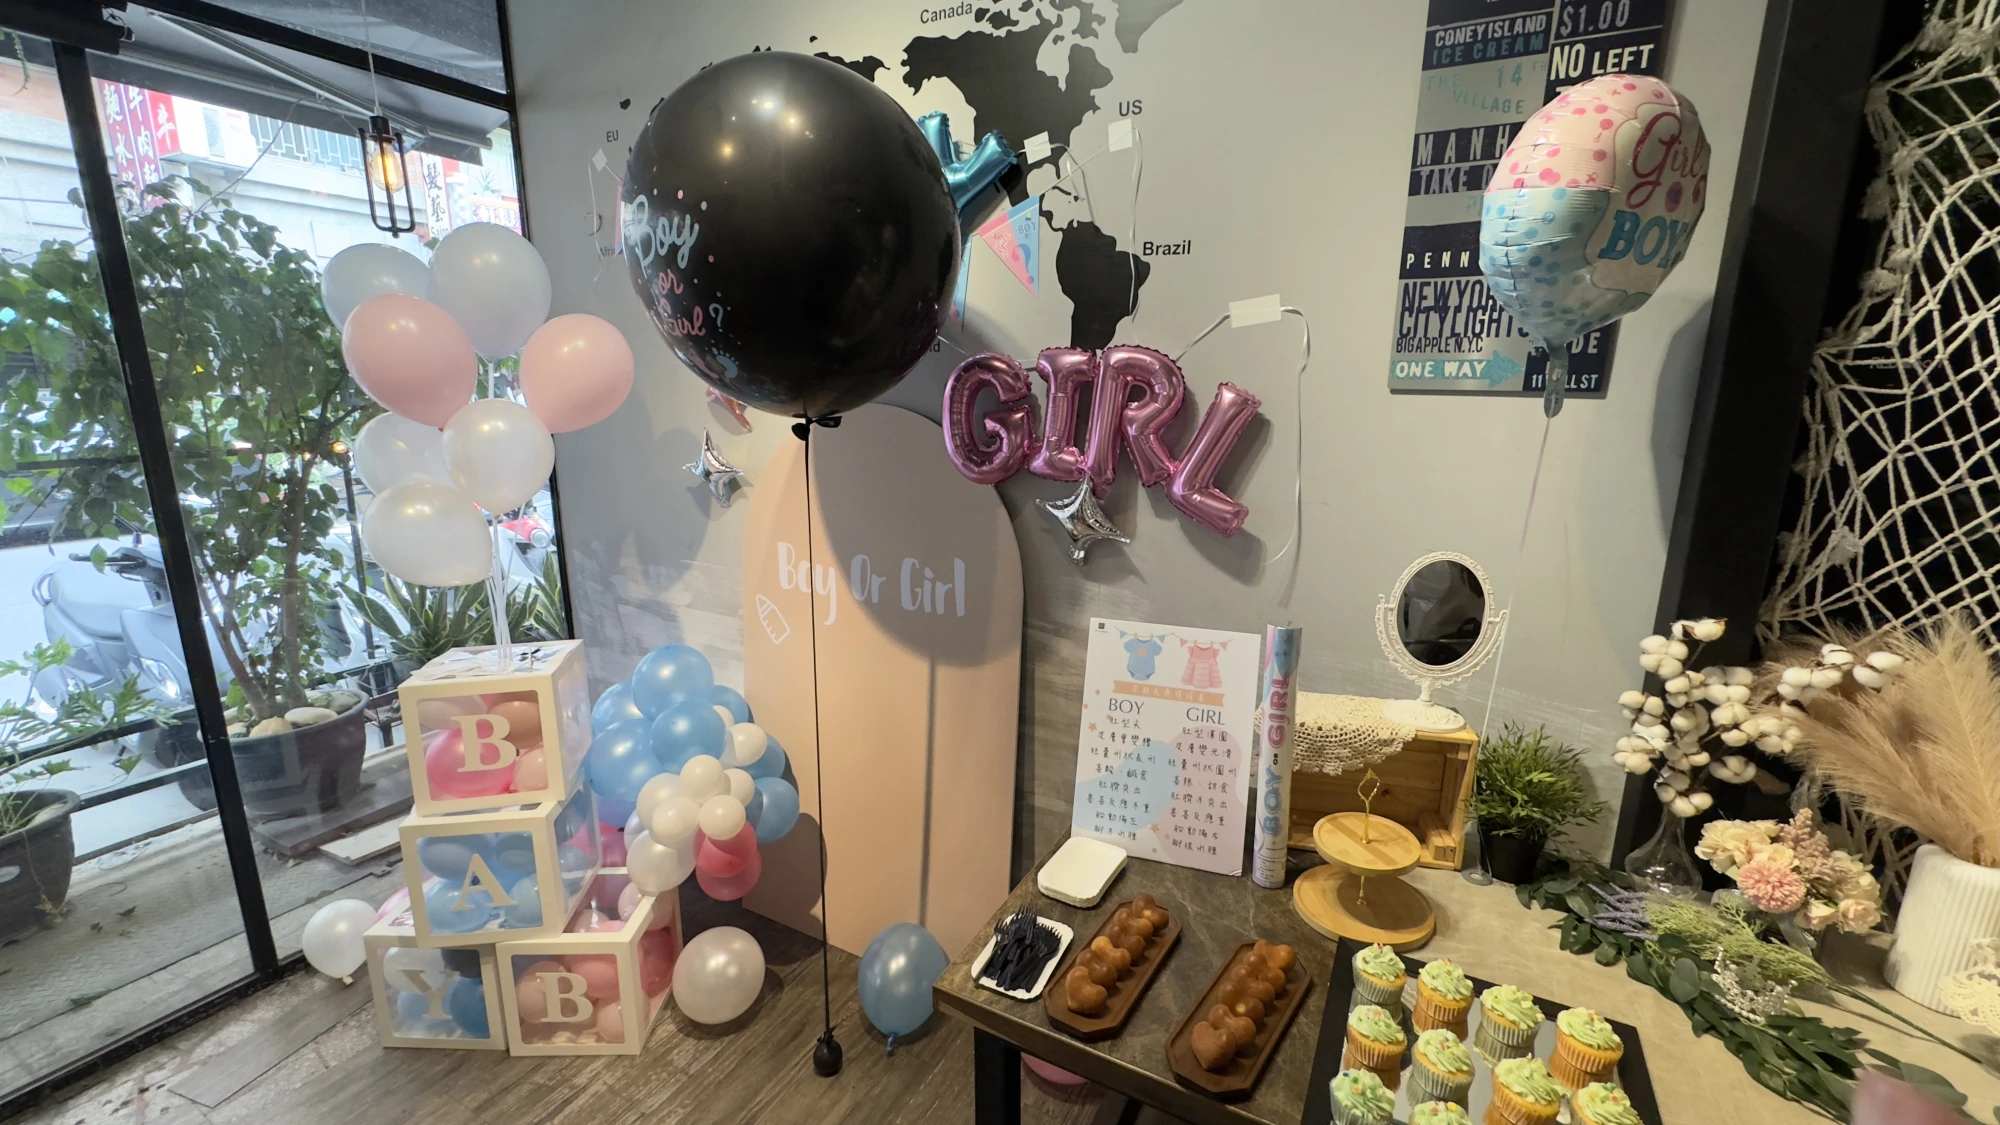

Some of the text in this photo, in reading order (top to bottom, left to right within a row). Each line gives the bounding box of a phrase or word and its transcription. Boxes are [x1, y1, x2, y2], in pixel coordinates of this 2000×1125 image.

[919, 2, 974, 24] Canada
[1560, 0, 1630, 37] $1.00
[1432, 33, 1545, 66] ICE CREAM
[1550, 43, 1655, 81] NO LEFT
[1119, 100, 1143, 117] US
[1453, 88, 1526, 115] VILLAGE
[606, 129, 619, 143] EU
[1417, 125, 1511, 166] MANH
[1625, 111, 1704, 210] Girl
[1420, 166, 1470, 196] TAKE
[629, 194, 700, 269] Boy
[1018, 220, 1037, 235] BOY
[1142, 239, 1192, 257] Brazil
[657, 268, 685, 296] or
[1395, 360, 1488, 379] ONE WAY
[942, 344, 1262, 538] GIRL
[776, 540, 966, 626] Boy Or Girl
[1108, 697, 1145, 715] BOY
[1186, 706, 1227, 726] GIRL
[1267, 671, 1291, 749] GIRL
[449, 713, 518, 774] B
[1262, 766, 1284, 838] BOY
[449, 852, 518, 913] A
[396, 968, 595, 1024] Y B
